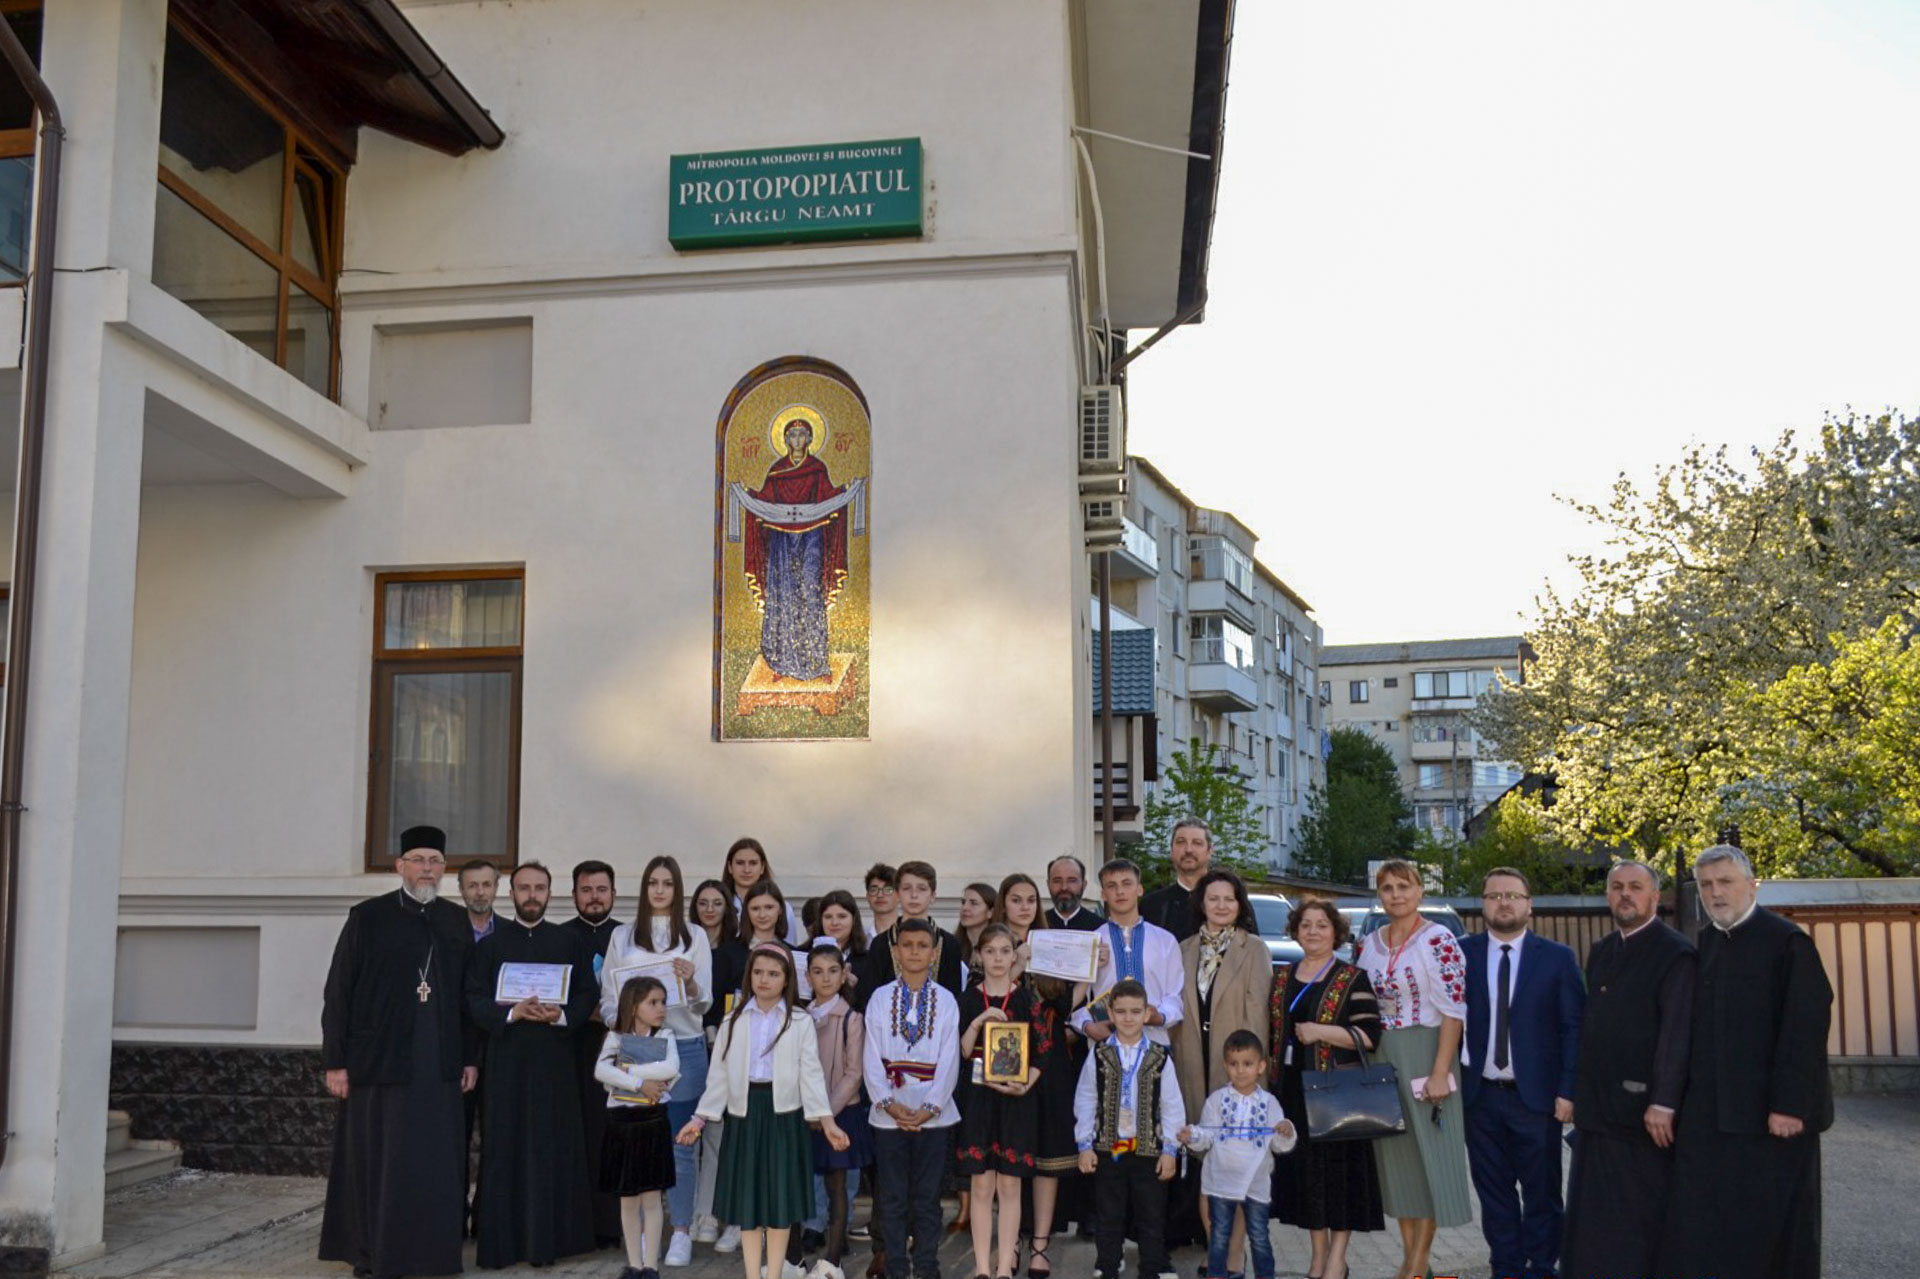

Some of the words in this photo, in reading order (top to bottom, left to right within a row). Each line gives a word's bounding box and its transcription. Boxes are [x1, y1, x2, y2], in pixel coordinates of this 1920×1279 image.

[686, 157, 758, 170] MITROPOLIA
[760, 152, 820, 165] MOLDOVEI
[838, 146, 903, 160] BUCOVINEI
[679, 168, 911, 205] PROTOPOPIATUL
[710, 208, 787, 225] TÂRGU
[798, 202, 877, 219] NEAMT
